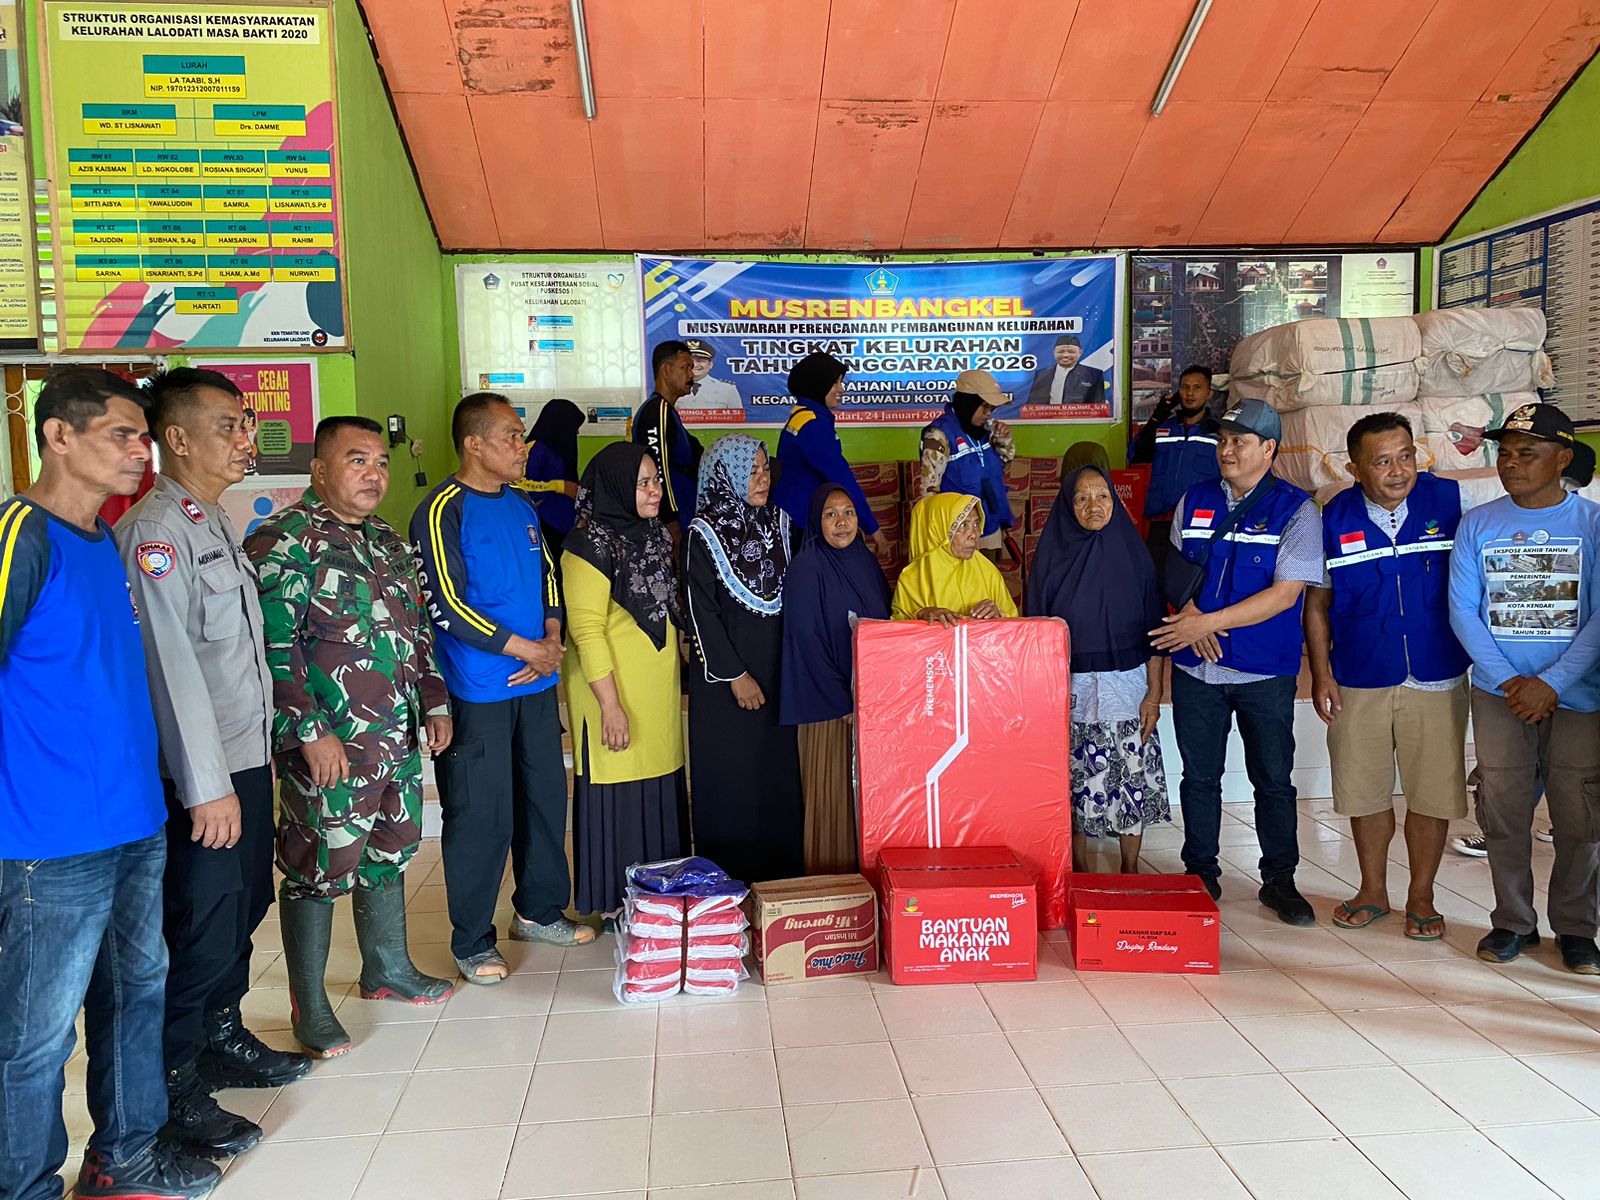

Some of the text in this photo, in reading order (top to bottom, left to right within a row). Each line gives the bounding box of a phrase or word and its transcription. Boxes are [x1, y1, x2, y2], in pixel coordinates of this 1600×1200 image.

[63, 13, 314, 26] STRUKTUR ORGANISASI KEMASYARAKATAN
[72, 26, 308, 38] KELURAHAN LALODATI MASA BAKTI 2020
[182, 77, 206, 85] TAABI,
[730, 297, 1033, 319] MUSRENBANGKEL
[687, 320, 1075, 334] MUSYAWARAH PERENCANAAN PEMBANGUNAN KELURAHAN
[742, 338, 1020, 355] TINGKAT KELURAHAN
[729, 355, 1036, 373] TAHU NGGARAN 2026
[258, 370, 289, 390] CEGAH
[896, 381, 957, 391] LALODA
[243, 392, 291, 412] STUNTING
[752, 394, 951, 404] KECAM PUUWATU KOTA
[866, 411, 878, 420] 24
[881, 411, 920, 422] Januari
[922, 410, 944, 420] 202
[140, 544, 171, 552] BINMAS
[411, 540, 450, 631] TAGANA
[926, 656, 934, 717] #KEMENSOS
[784, 914, 834, 930] goreng
[922, 917, 1008, 934] BANTUAN
[824, 932, 846, 941] Instan
[920, 932, 1010, 948] MAKANAN
[940, 947, 990, 962] ANAK
[1116, 940, 1178, 954] Daging Rendang
